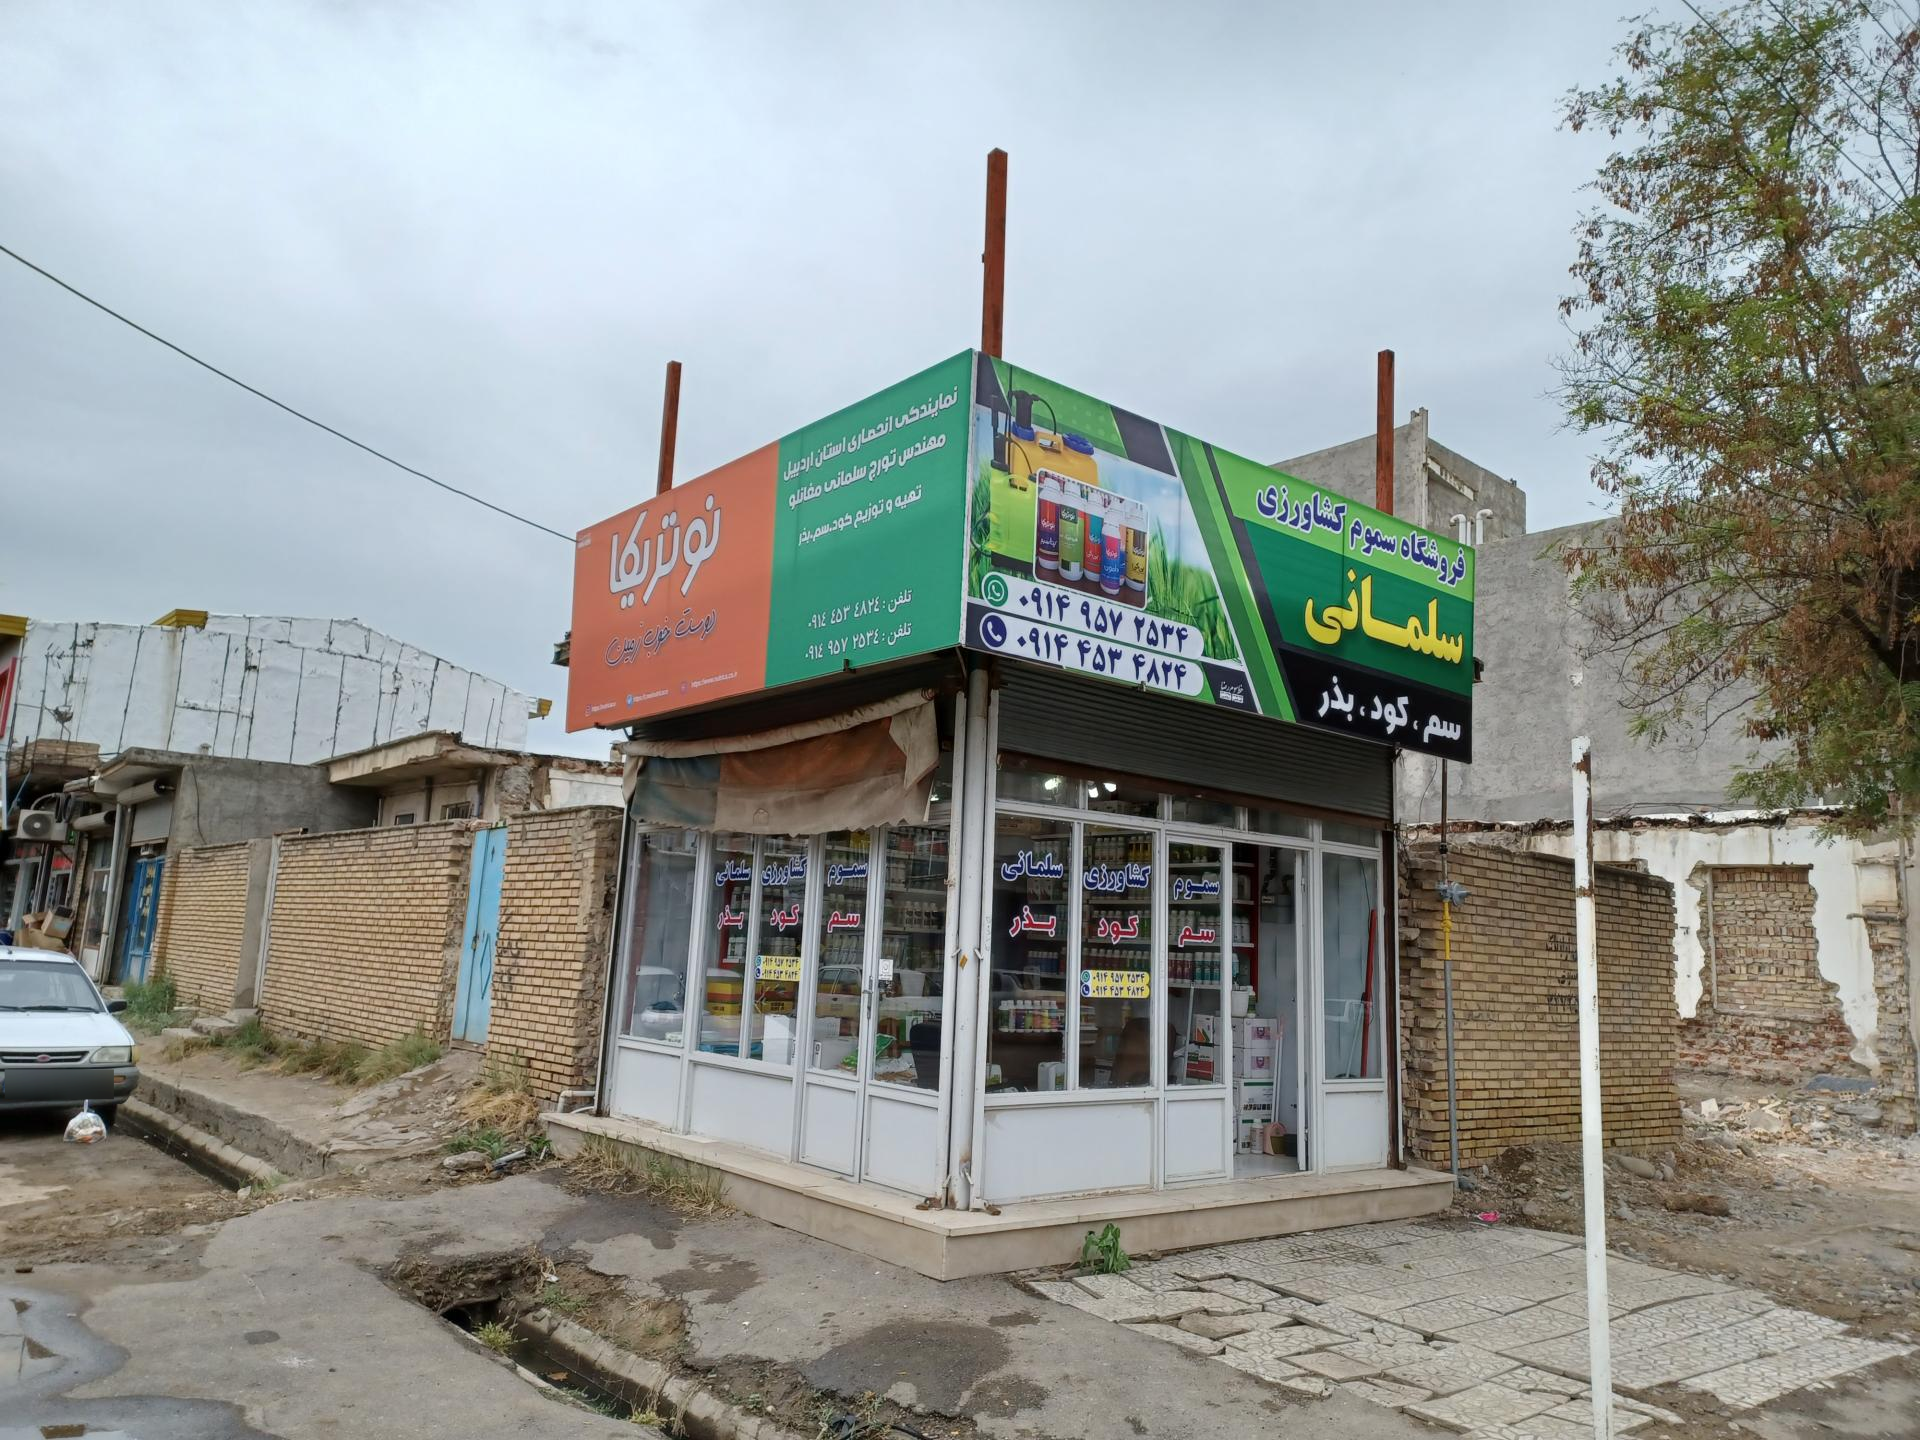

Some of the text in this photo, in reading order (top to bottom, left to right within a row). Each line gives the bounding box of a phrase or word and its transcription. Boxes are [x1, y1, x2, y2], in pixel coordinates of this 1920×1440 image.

[847, 415, 893, 454] انحصاری
[815, 437, 846, 467] استان
[783, 456, 813, 481] اردبیل
[788, 433, 946, 509] مهندس تورج سلمانی مغانلو
[853, 499, 884, 518] توزیع
[886, 499, 893, 513] و
[895, 484, 922, 509] تهیه
[1255, 483, 1467, 587] فروشگاه سموم کشاورزی
[609, 493, 722, 610] نوتریکا
[1019, 587, 1189, 653] ۰۹۱۴ ۹۵۷ ۲۵۳۴
[1304, 568, 1463, 664] سلمانی
[1017, 627, 1187, 690] ۰۹۱۴ ۴۵۳ ۴۸۲۴
[1318, 675, 1355, 722] بذر
[715, 856, 868, 887] سموم کشاورزی سلمانی
[1001, 850, 1220, 900] سموم کشاورزی سلمانی
[717, 903, 860, 933] سم کود بذر
[1009, 906, 1056, 937] بذر
[1098, 915, 1139, 944] کود
[1178, 926, 1215, 947] سم
[1093, 971, 1145, 983] ۰۹۱۴ ۹۵۷ ۲۵۳۴
[1093, 985, 1145, 996] ۰۹۱۴ ۴۵۳ ۴۸۲۴
